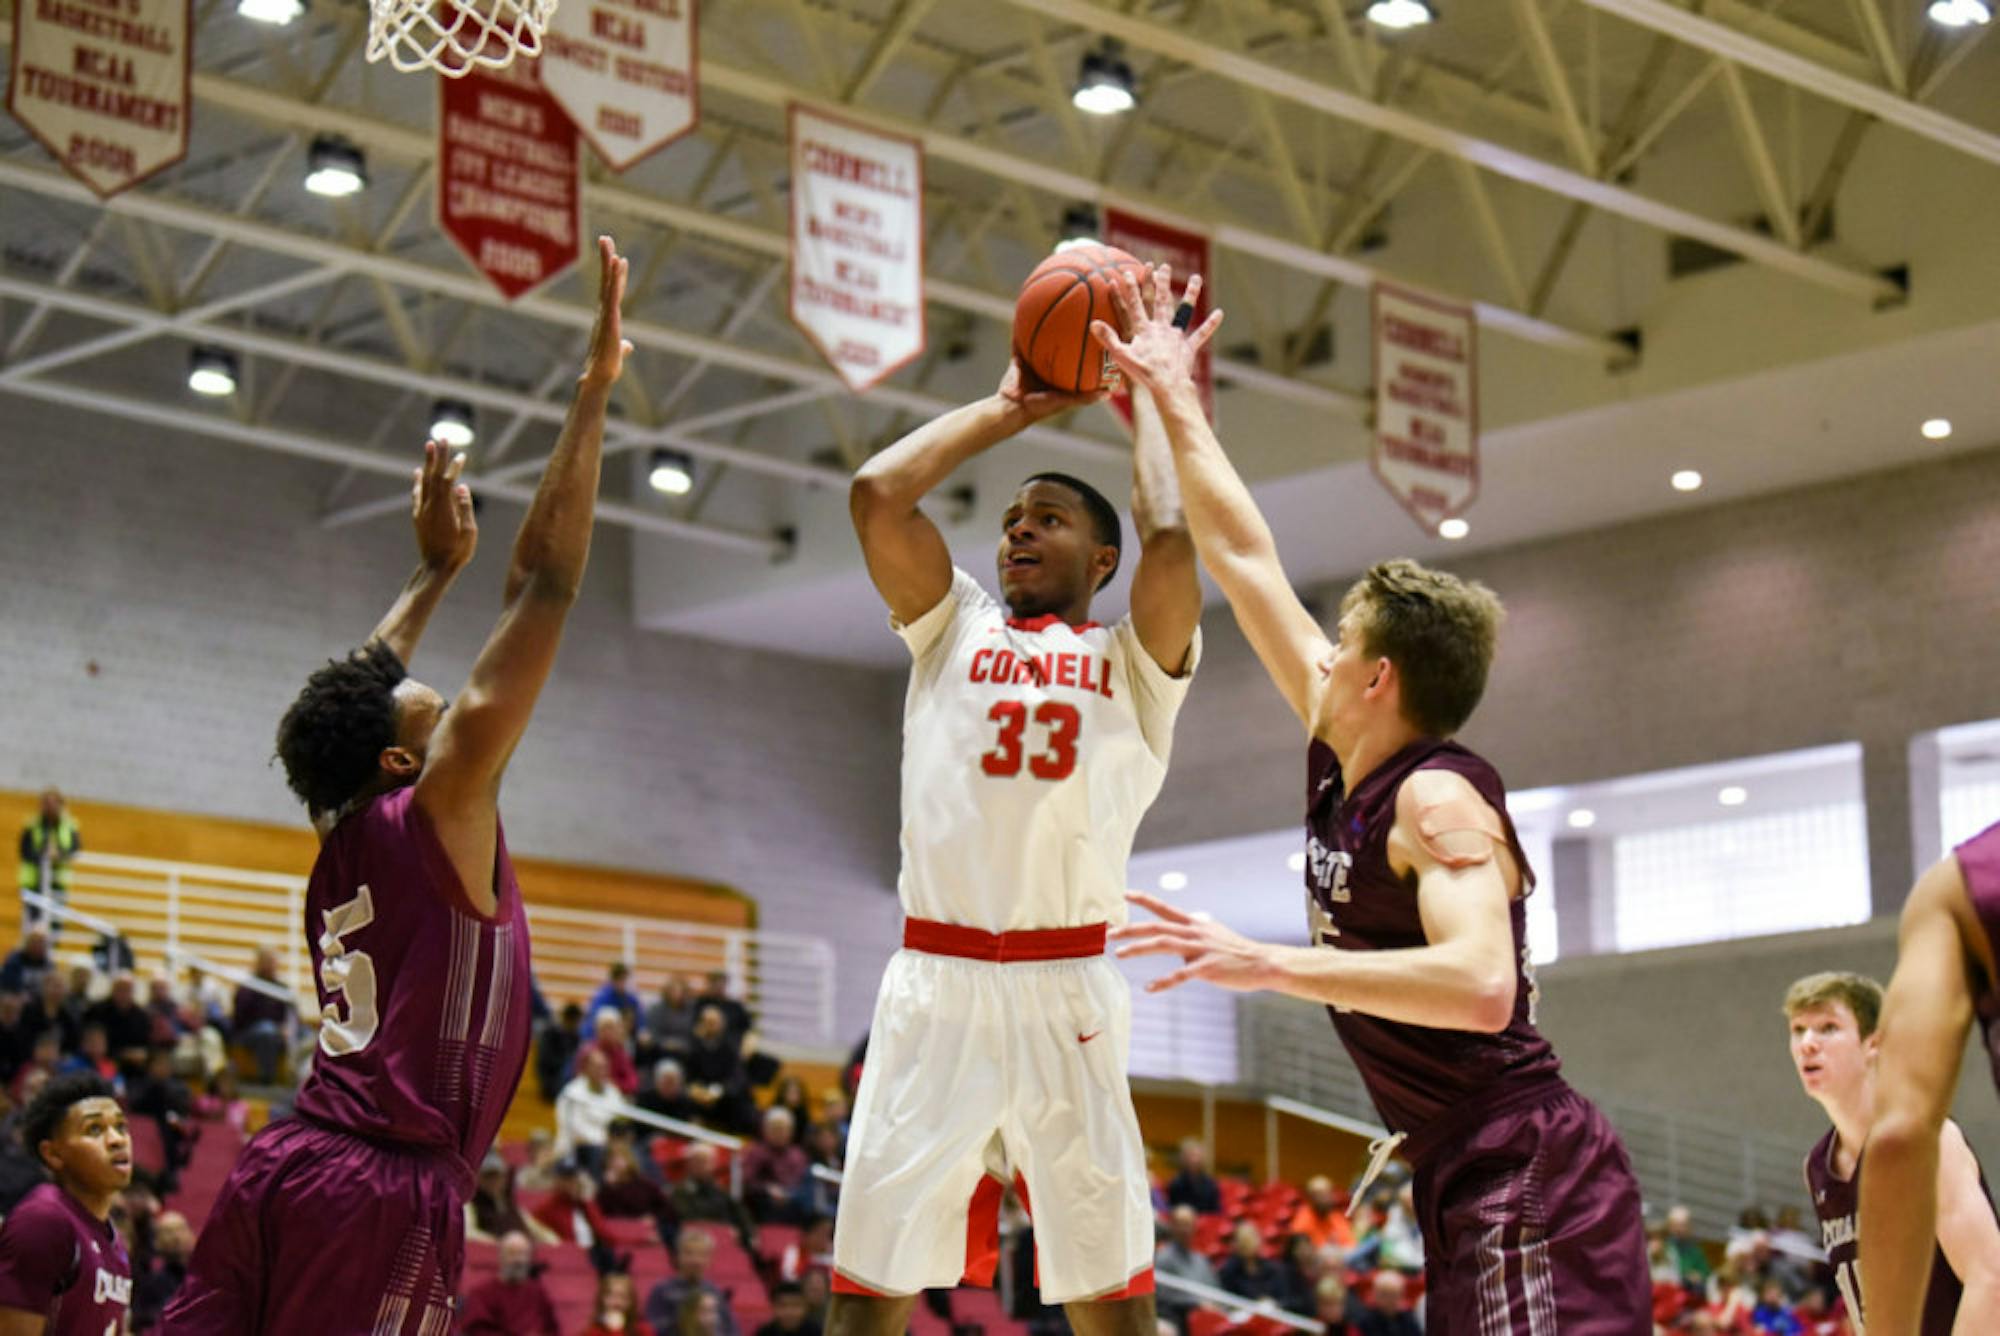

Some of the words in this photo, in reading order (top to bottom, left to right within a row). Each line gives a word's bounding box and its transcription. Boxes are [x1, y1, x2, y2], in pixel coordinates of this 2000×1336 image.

[23, 64, 178, 133] TOURNAMENT
[969, 647, 1115, 700] CORNELL
[980, 700, 1083, 781] 33
[318, 883, 378, 1058] 5
